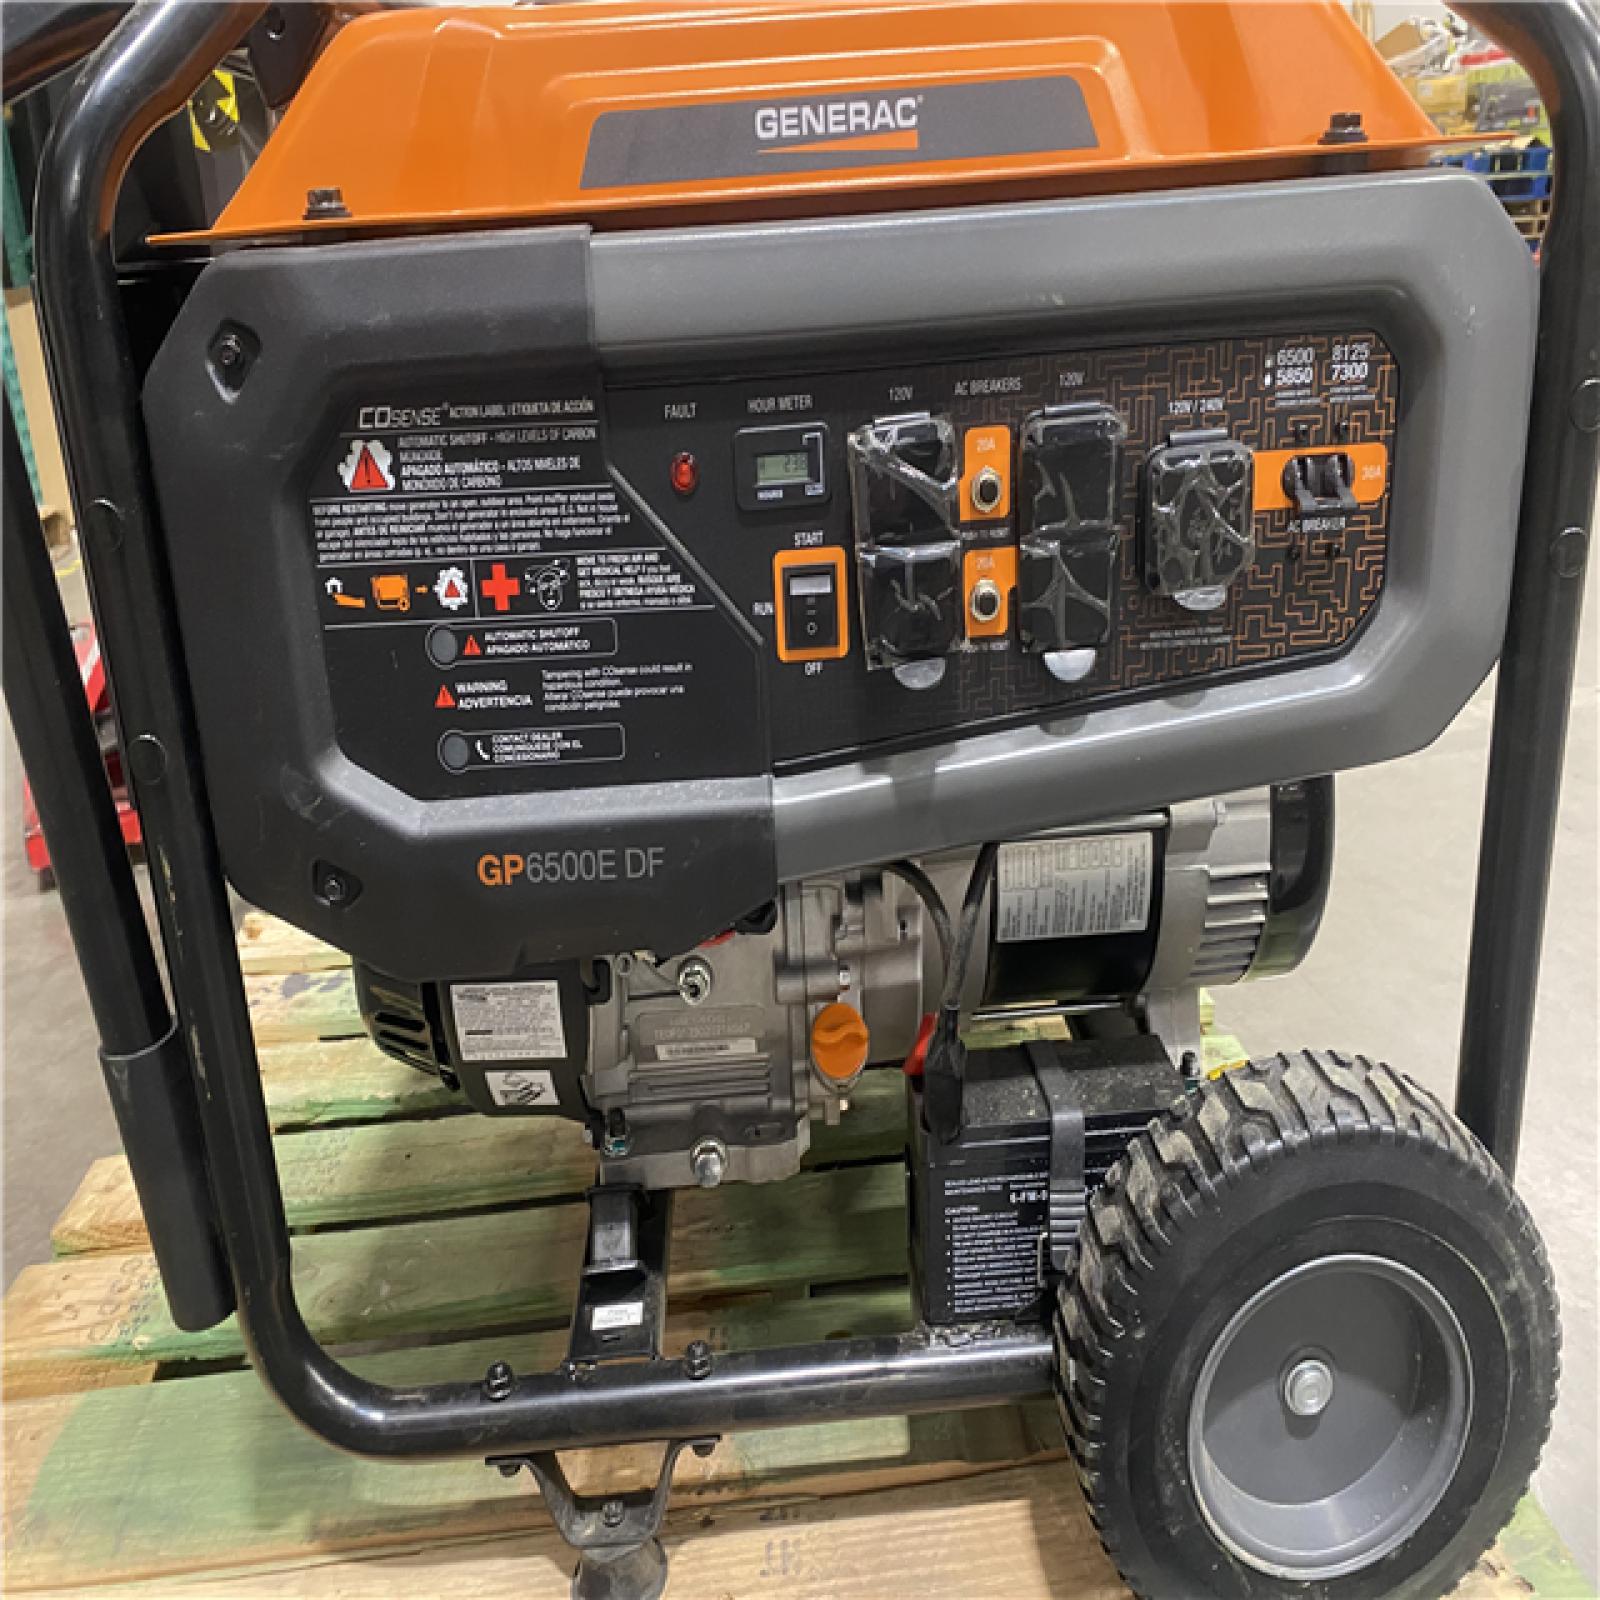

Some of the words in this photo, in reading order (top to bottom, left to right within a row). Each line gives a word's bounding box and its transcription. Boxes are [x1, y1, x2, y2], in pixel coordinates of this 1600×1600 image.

[755, 96, 918, 140] GENERAC
[969, 376, 1023, 396] BREAKERS
[664, 402, 697, 419] FAULT
[747, 397, 776, 413] HOUR
[777, 394, 813, 411] METER
[794, 530, 824, 546] START
[752, 601, 774, 615] RUN
[804, 661, 823, 676] OFF
[454, 679, 508, 693] WARNING
[456, 694, 533, 710] ADVERTENCIA
[477, 848, 618, 886] GP6500E
[624, 846, 666, 879] DF
